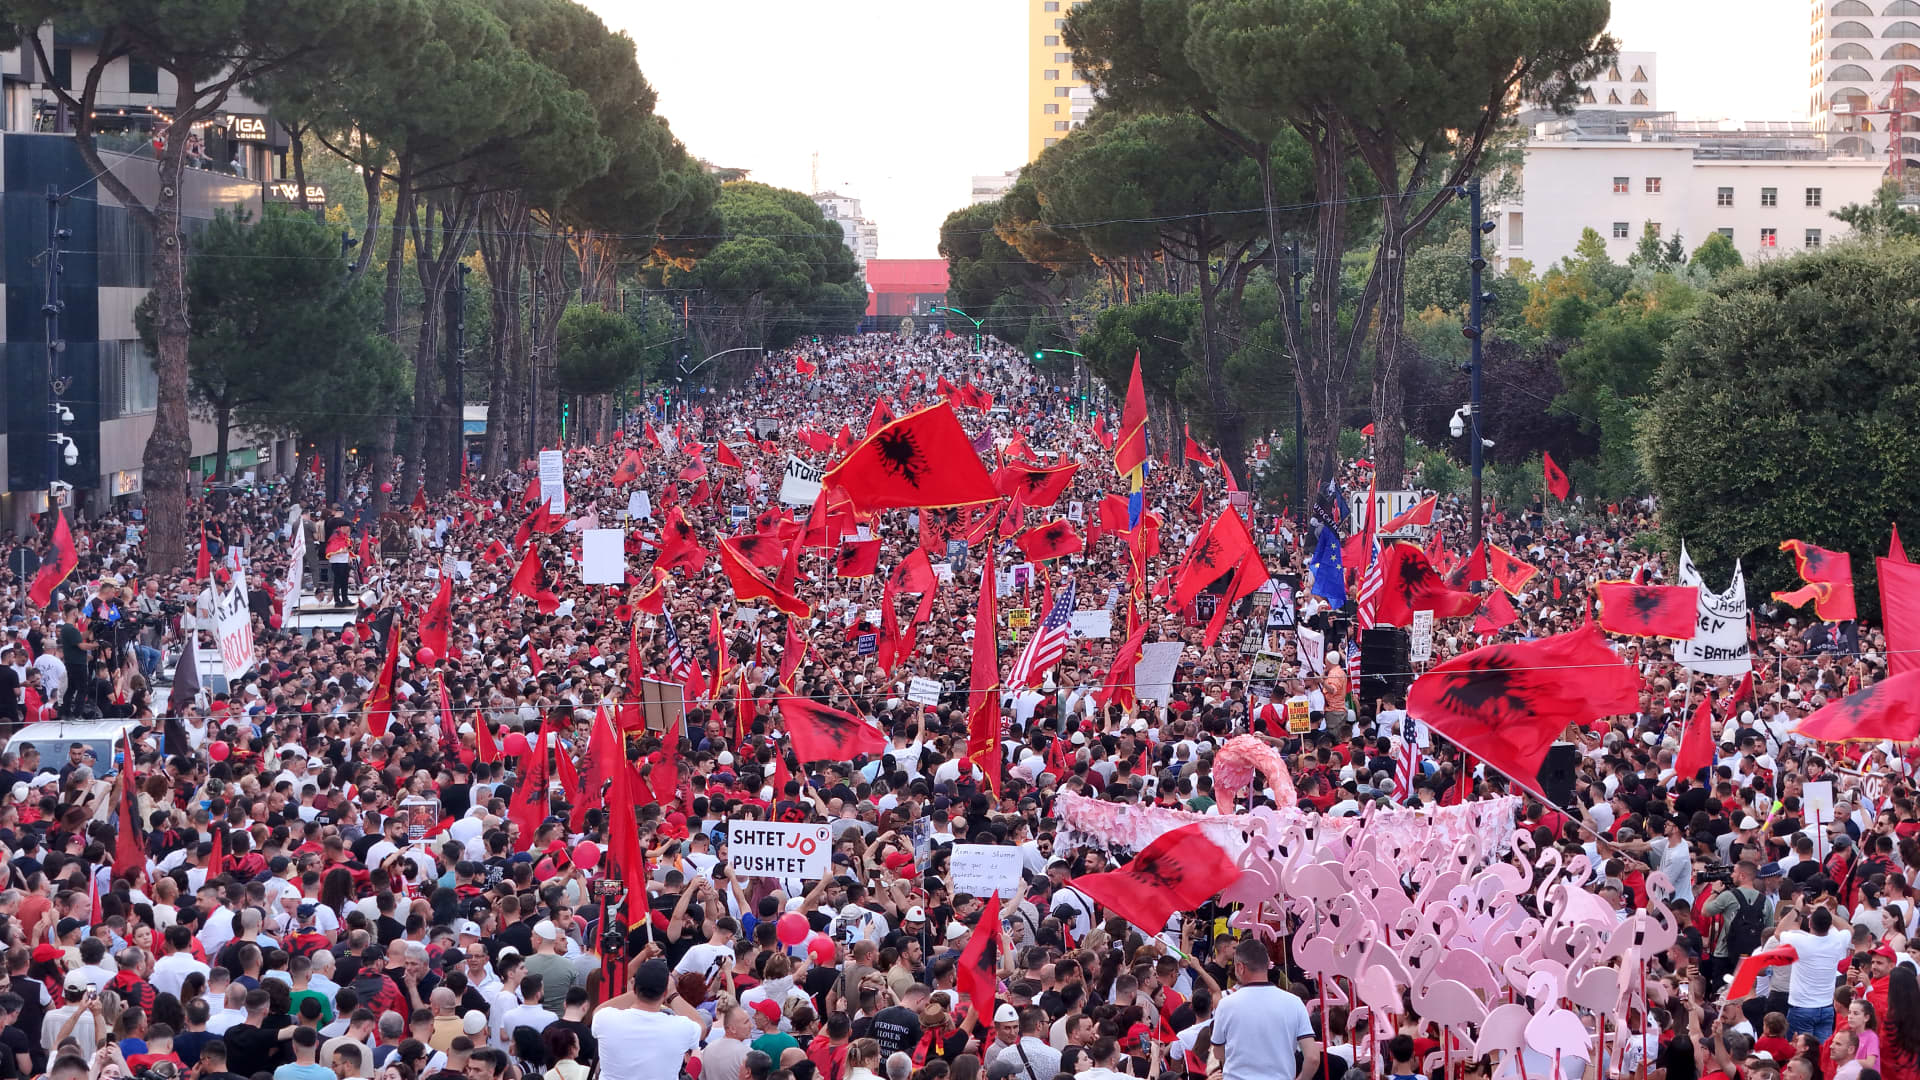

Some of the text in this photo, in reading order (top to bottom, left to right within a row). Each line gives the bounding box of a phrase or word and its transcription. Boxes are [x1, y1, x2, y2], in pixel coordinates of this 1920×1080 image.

[270, 184, 325, 200] TWGA
[733, 830, 816, 855] SHTET JO
[733, 856, 806, 873] PUSHTET
